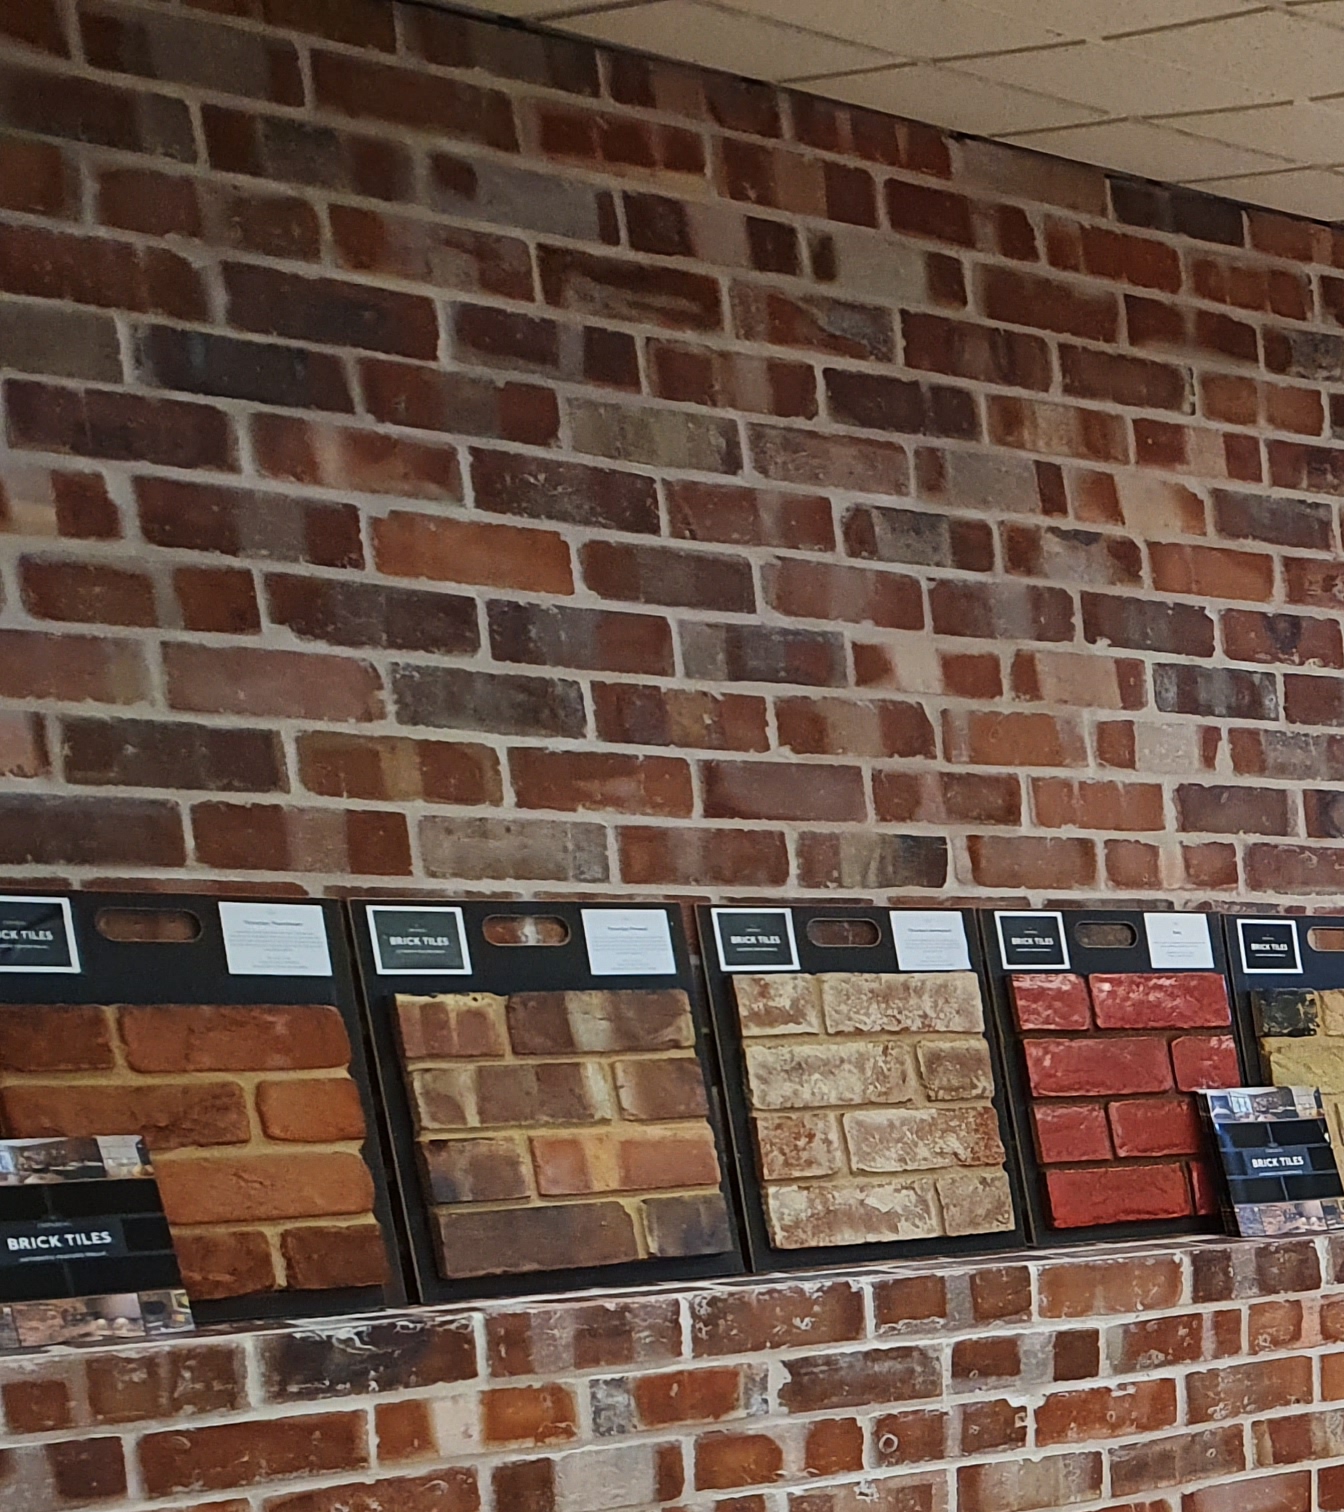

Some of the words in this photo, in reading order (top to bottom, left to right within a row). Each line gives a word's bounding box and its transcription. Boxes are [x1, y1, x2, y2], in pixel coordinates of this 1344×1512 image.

[20, 930, 53, 941] TILES
[389, 935, 421, 946] BRICK
[421, 936, 450, 946] TILES
[730, 935, 758, 944] BRICK
[758, 935, 781, 944] TILES
[1011, 937, 1034, 945] BRICK
[1035, 937, 1054, 945] TILES
[1250, 943, 1270, 951] BRICK
[1271, 943, 1288, 951] TILES
[1252, 1158, 1279, 1168] BRICK
[1279, 1156, 1304, 1166] TILES
[7, 1235, 63, 1251] BRICK
[64, 1231, 112, 1246] TILES
